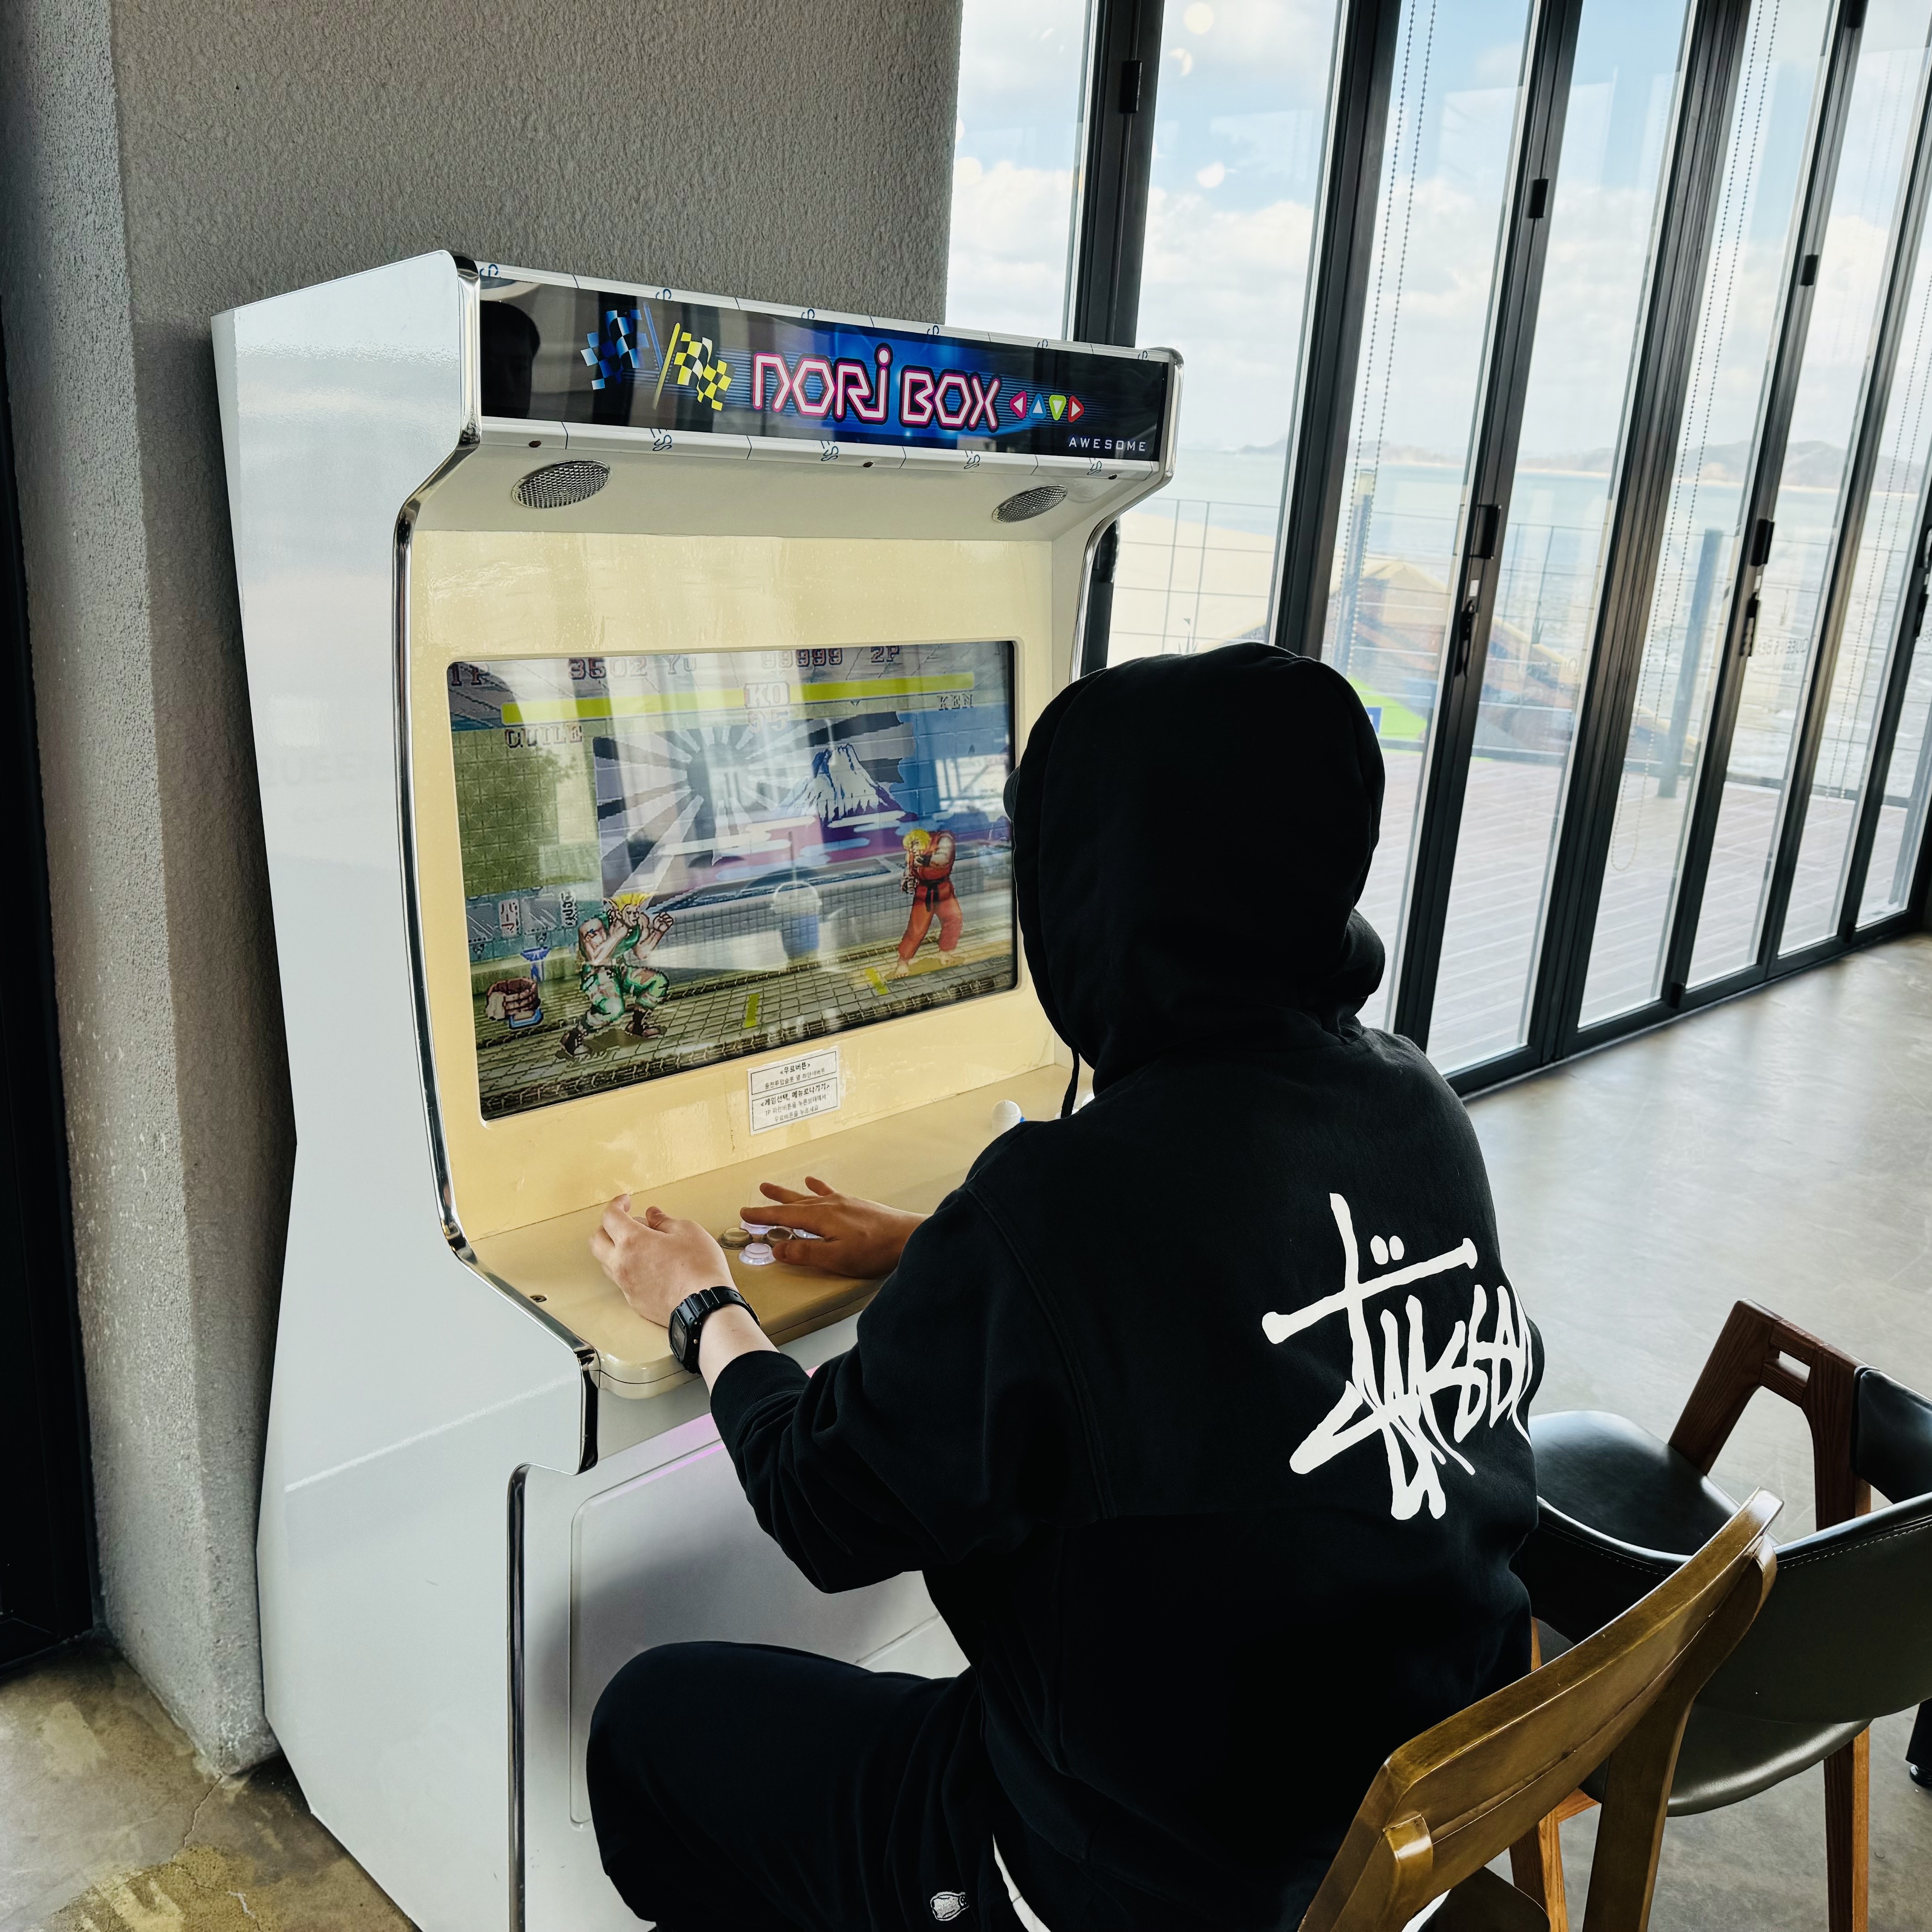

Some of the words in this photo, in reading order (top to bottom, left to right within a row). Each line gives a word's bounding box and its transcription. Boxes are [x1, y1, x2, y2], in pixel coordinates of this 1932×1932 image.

[902, 368, 1000, 431] BOX
[1068, 437, 1146, 451] AWESOME
[870, 646, 900, 663] 2P
[744, 681, 791, 708] KO
[937, 694, 974, 711] KEN
